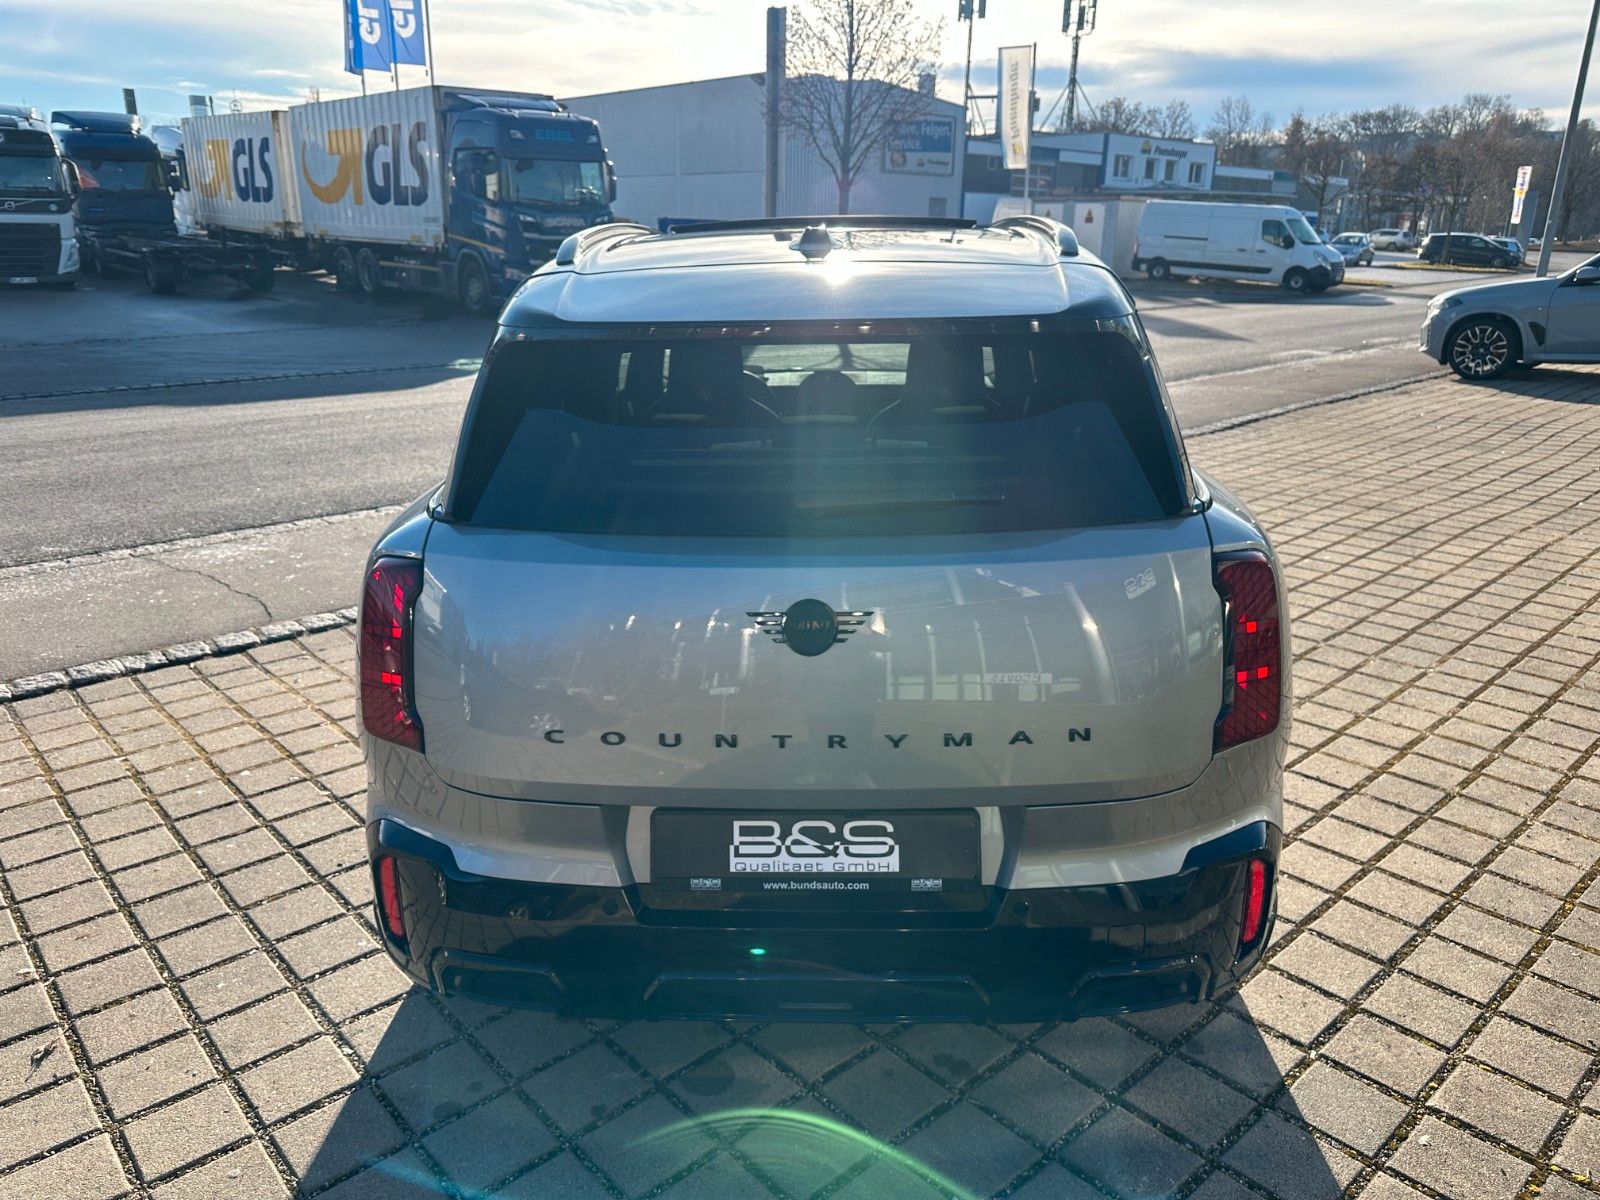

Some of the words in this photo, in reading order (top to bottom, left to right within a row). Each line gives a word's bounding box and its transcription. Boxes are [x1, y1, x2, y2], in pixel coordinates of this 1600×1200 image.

[534, 128, 574, 141] EBEL
[233, 137, 273, 203] GLS
[366, 121, 429, 206] GLS
[543, 726, 1092, 749] COUNTRYMAN
[733, 820, 895, 858] B&S
[734, 860, 824, 872] Qualitaet
[832, 860, 891, 872] GmbH
[763, 880, 869, 891] www.bundsauto.com
